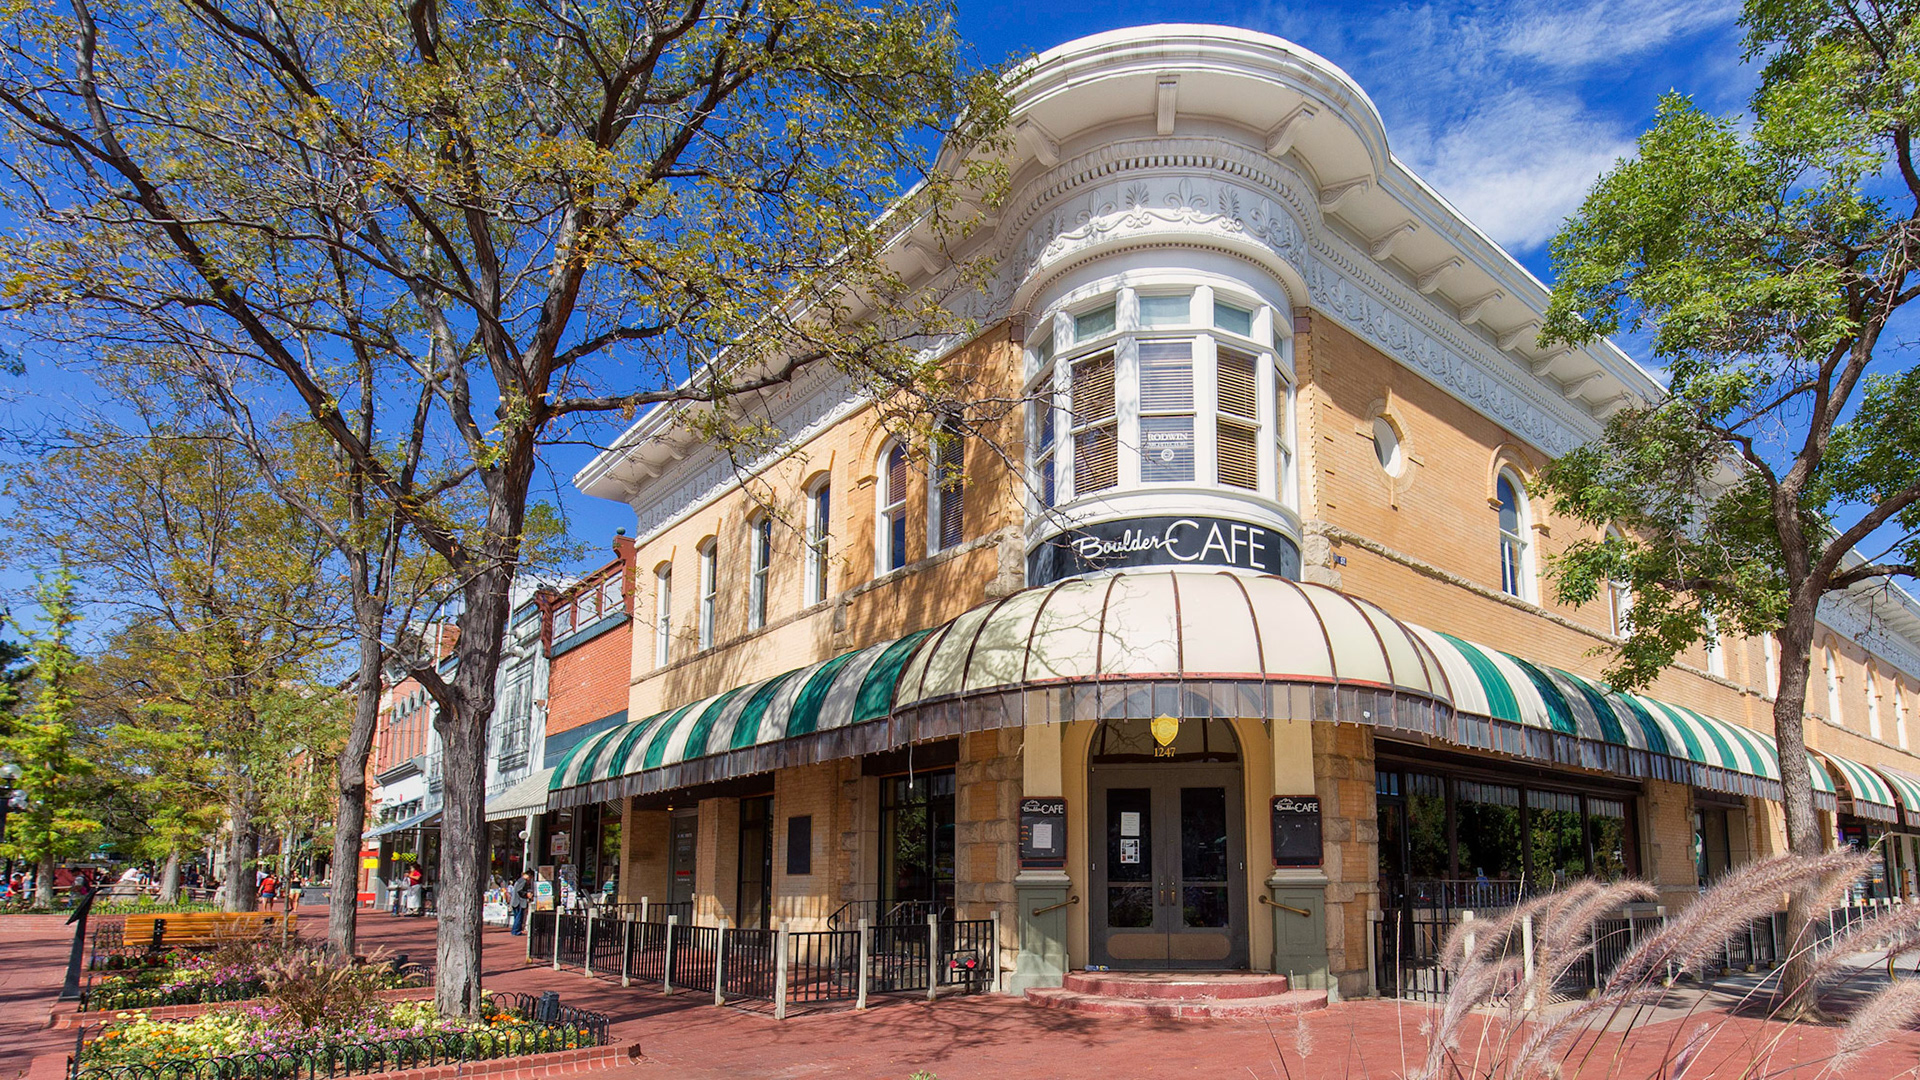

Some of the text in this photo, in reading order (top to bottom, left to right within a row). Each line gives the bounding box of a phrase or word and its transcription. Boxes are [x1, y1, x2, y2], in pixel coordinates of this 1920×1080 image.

[1072, 519, 1265, 570] Boulder CAFE
[1154, 746, 1176, 757] 1247
[1041, 804, 1064, 814] CAFE
[1295, 802, 1318, 813] CAFE
